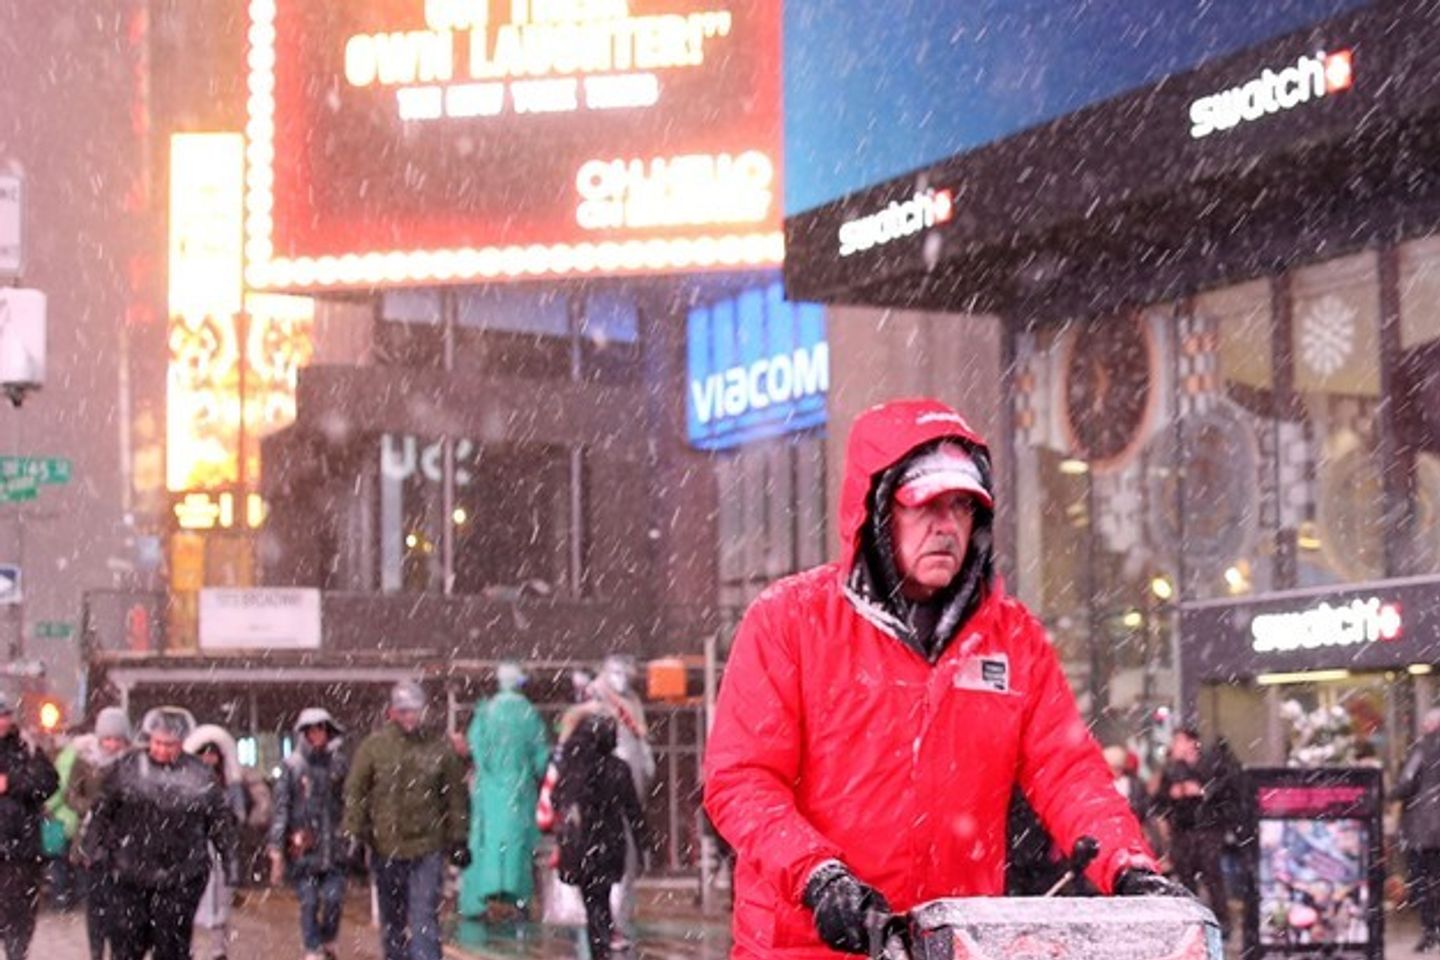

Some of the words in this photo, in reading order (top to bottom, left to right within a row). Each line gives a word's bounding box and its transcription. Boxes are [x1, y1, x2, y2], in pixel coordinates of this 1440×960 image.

[1189, 55, 1326, 138] swatch
[839, 191, 935, 257] swatch
[1252, 597, 1379, 652] swatch
